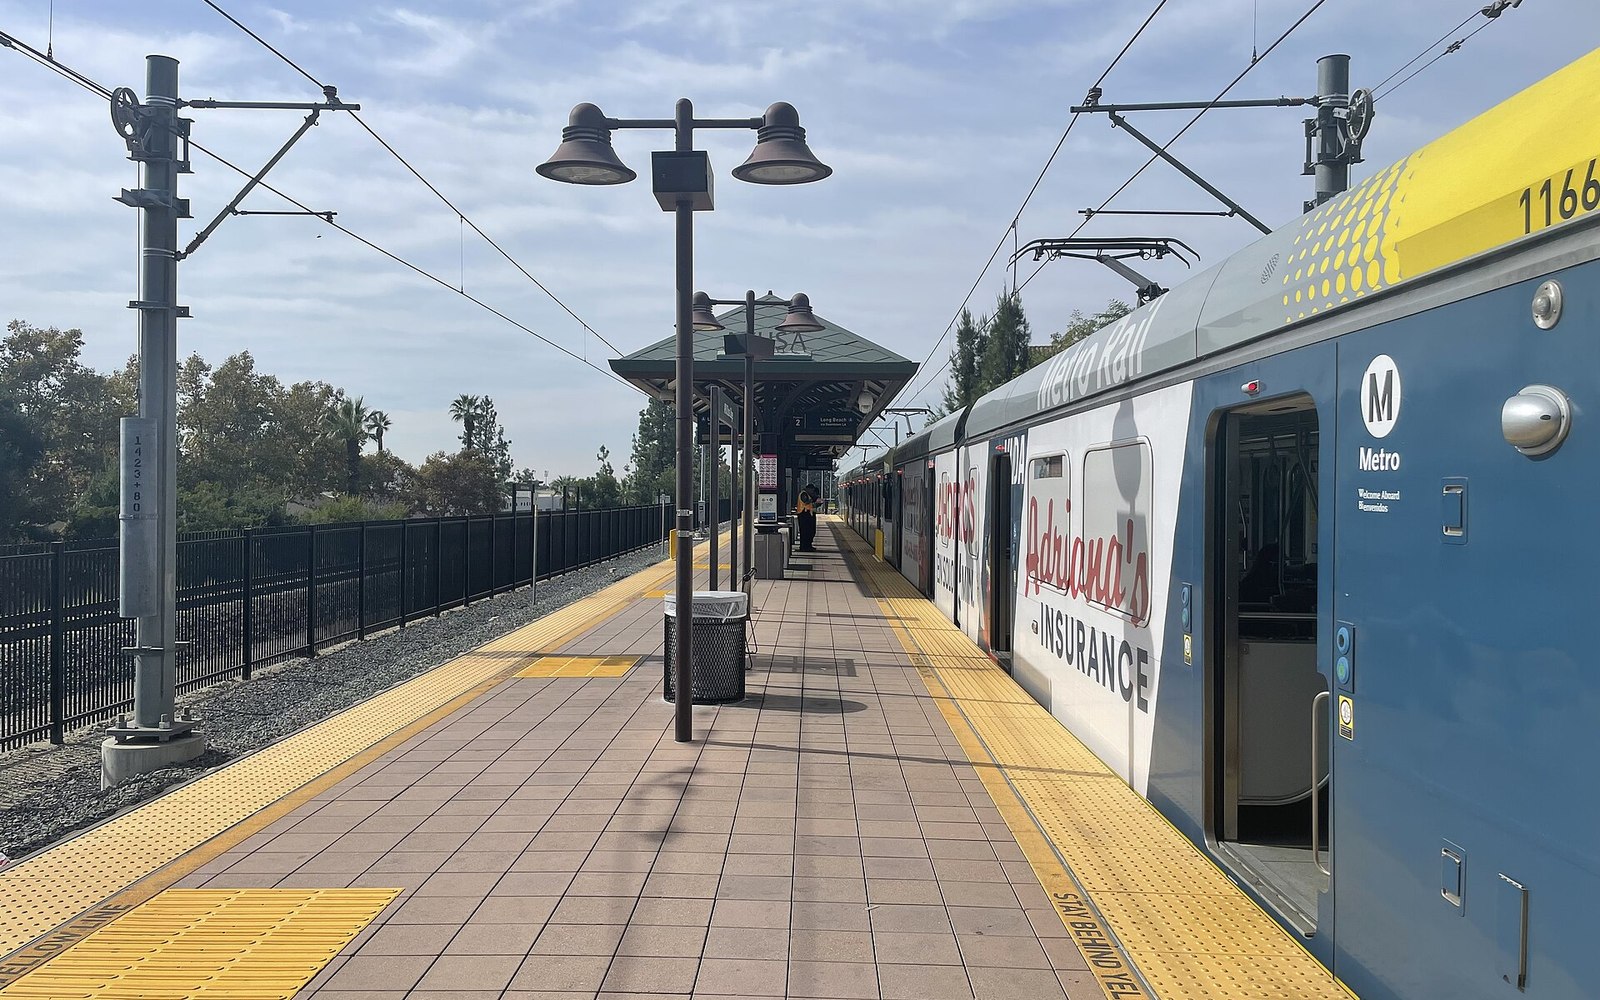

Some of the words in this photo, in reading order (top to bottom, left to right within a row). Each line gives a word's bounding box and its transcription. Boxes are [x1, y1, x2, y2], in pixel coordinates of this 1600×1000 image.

[1519, 158, 1600, 235] 1166
[1036, 341, 1098, 412] Metro
[1096, 294, 1168, 389] Rail
[795, 419, 801, 427] 2
[1368, 369, 1393, 423] M
[133, 436, 142, 512] 1423+80
[1358, 446, 1400, 471] Metro
[1357, 488, 1381, 500] Welcome
[1381, 490, 1400, 500] Aboard
[1358, 501, 1388, 513] Bienvenidos
[1024, 495, 1149, 628] Adriana's
[1040, 602, 1148, 714] INSURANCE
[1053, 892, 1092, 919] STAY
[0, 931, 82, 983] ELLOW
[69, 904, 134, 929] LINE
[1069, 921, 1123, 969] BEHIND
